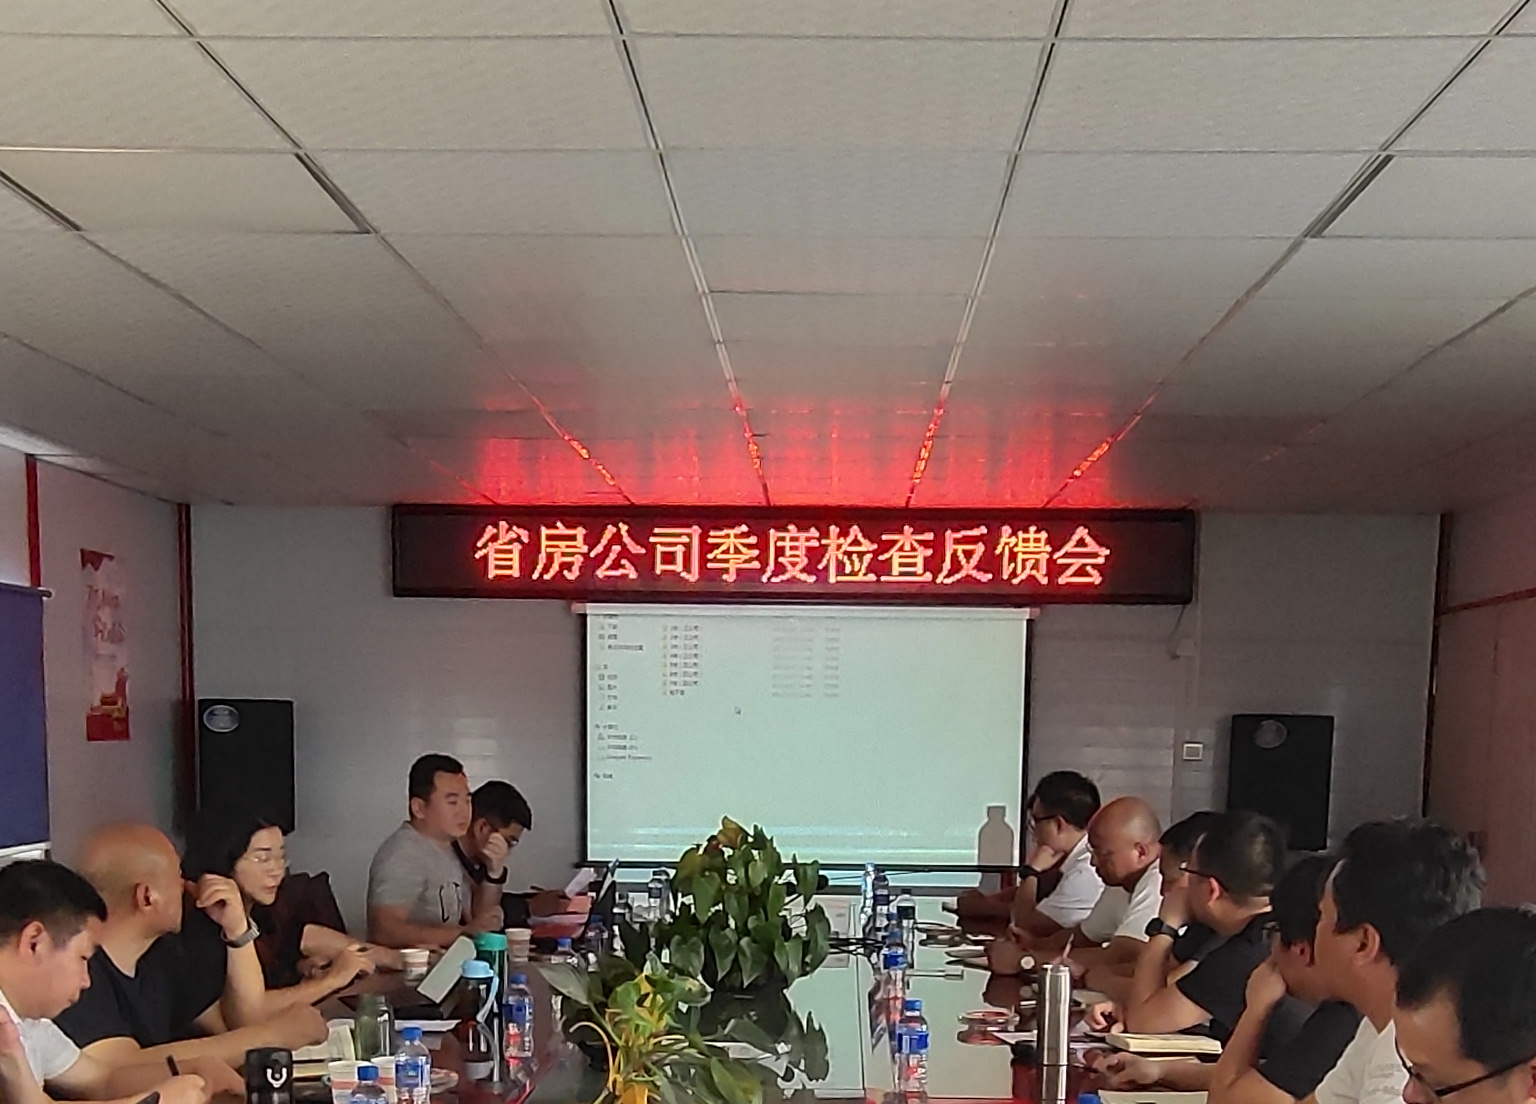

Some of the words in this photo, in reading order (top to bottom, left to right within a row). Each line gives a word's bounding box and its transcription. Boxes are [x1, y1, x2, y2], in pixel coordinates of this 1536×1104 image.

[474, 520, 1111, 587] 省房公司季度检查反馈会
